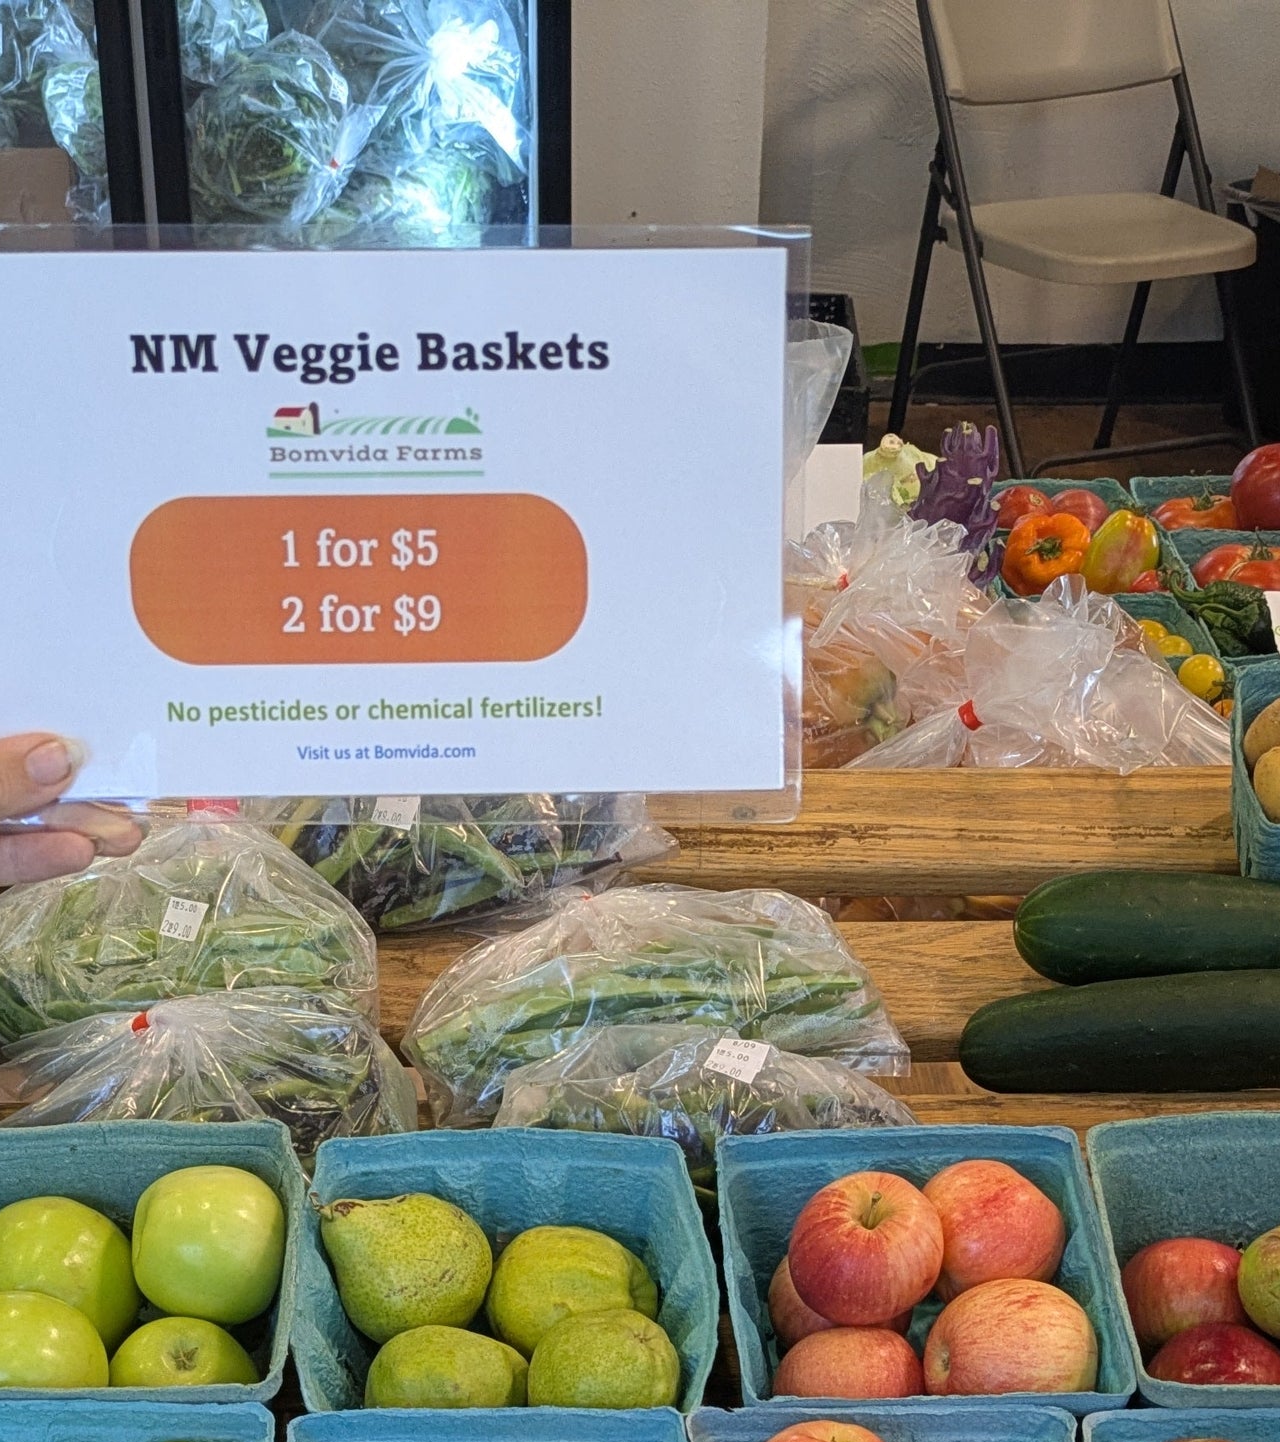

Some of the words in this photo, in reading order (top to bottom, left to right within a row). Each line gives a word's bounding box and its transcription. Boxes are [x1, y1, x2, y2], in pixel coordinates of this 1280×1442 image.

[130, 333, 218, 374] NM
[232, 332, 400, 384] Veggie
[417, 331, 610, 373] Baskets
[269, 446, 389, 463] Bomvida
[397, 445, 484, 462] Farms
[281, 530, 301, 568] 1
[317, 528, 379, 568] for
[391, 528, 439, 571] $5
[281, 597, 306, 633] 2
[320, 594, 381, 633] for
[394, 594, 442, 637] $9
[167, 701, 201, 723] No
[209, 699, 328, 727] pesticides
[335, 703, 360, 721] or
[368, 698, 473, 721] chemical
[481, 696, 603, 719] fertilizers!
[297, 746, 330, 761] Visit
[333, 749, 352, 761] us
[355, 747, 370, 761] at
[374, 744, 476, 760] Bomvida.com
